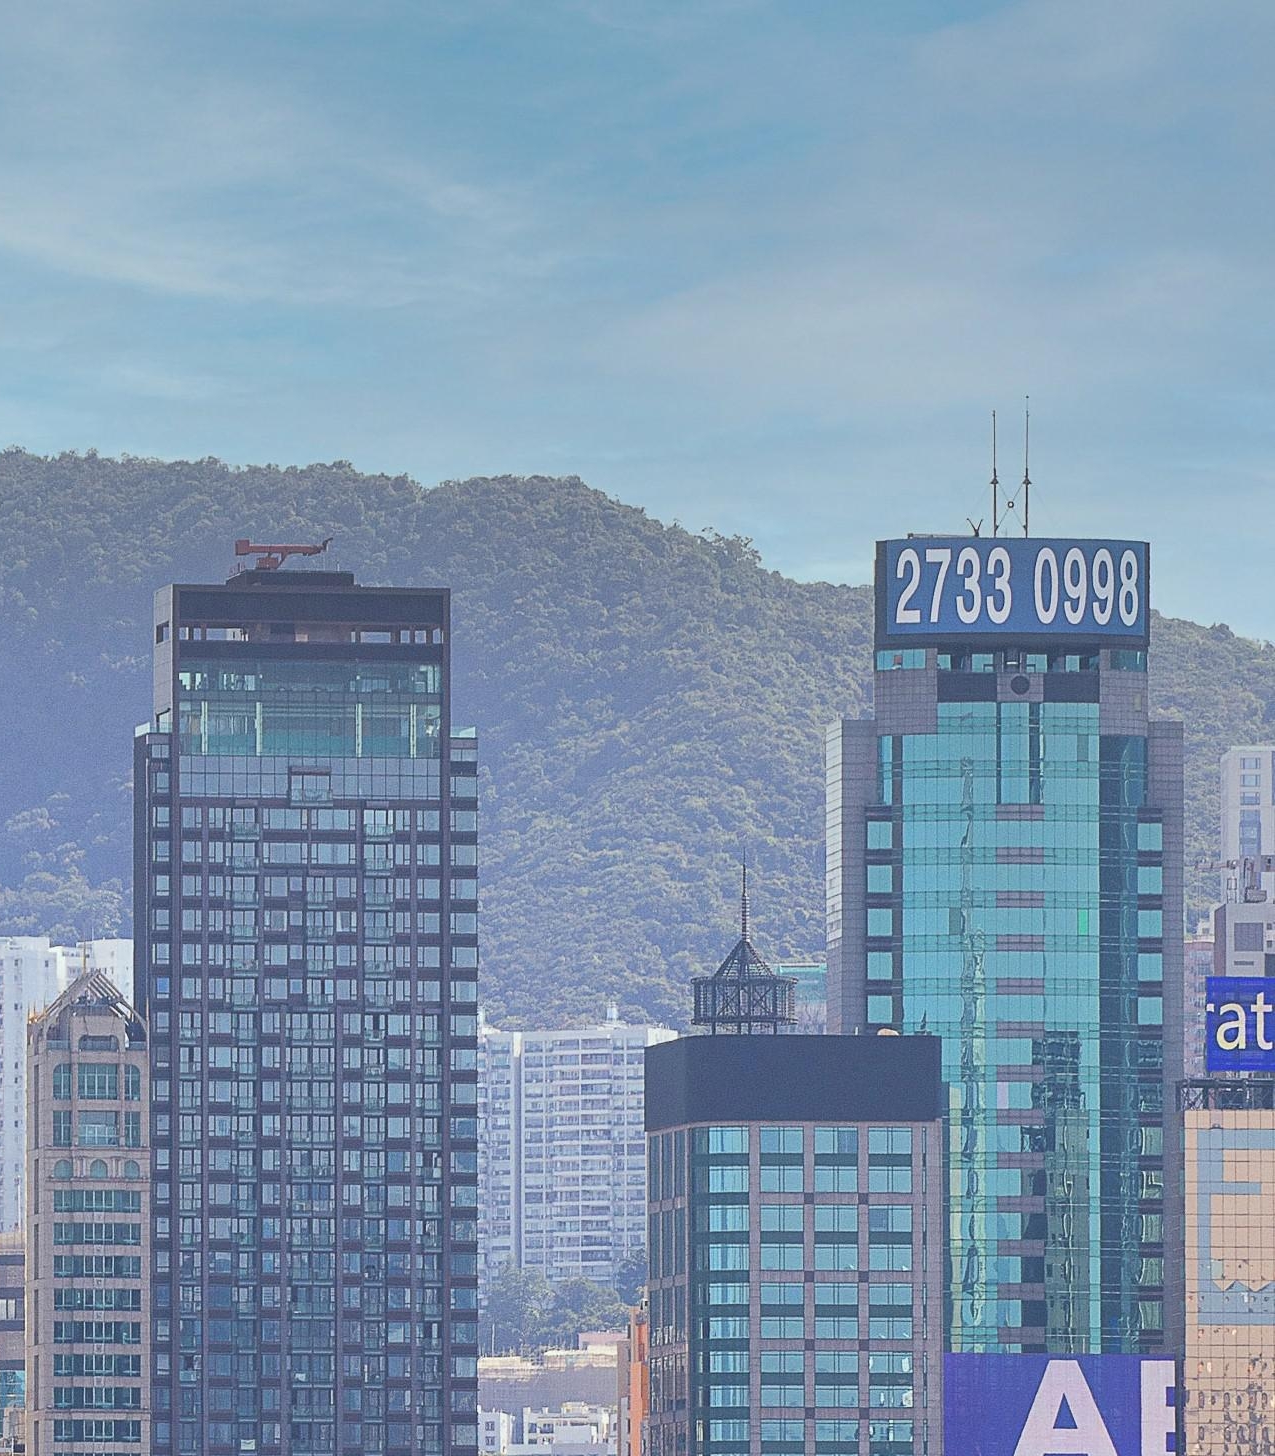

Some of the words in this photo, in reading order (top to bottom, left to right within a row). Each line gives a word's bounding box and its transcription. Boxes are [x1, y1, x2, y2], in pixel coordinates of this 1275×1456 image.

[895, 547, 1012, 624] 2733
[1034, 547, 1139, 626] 0998
[1206, 991, 1273, 1051] at
